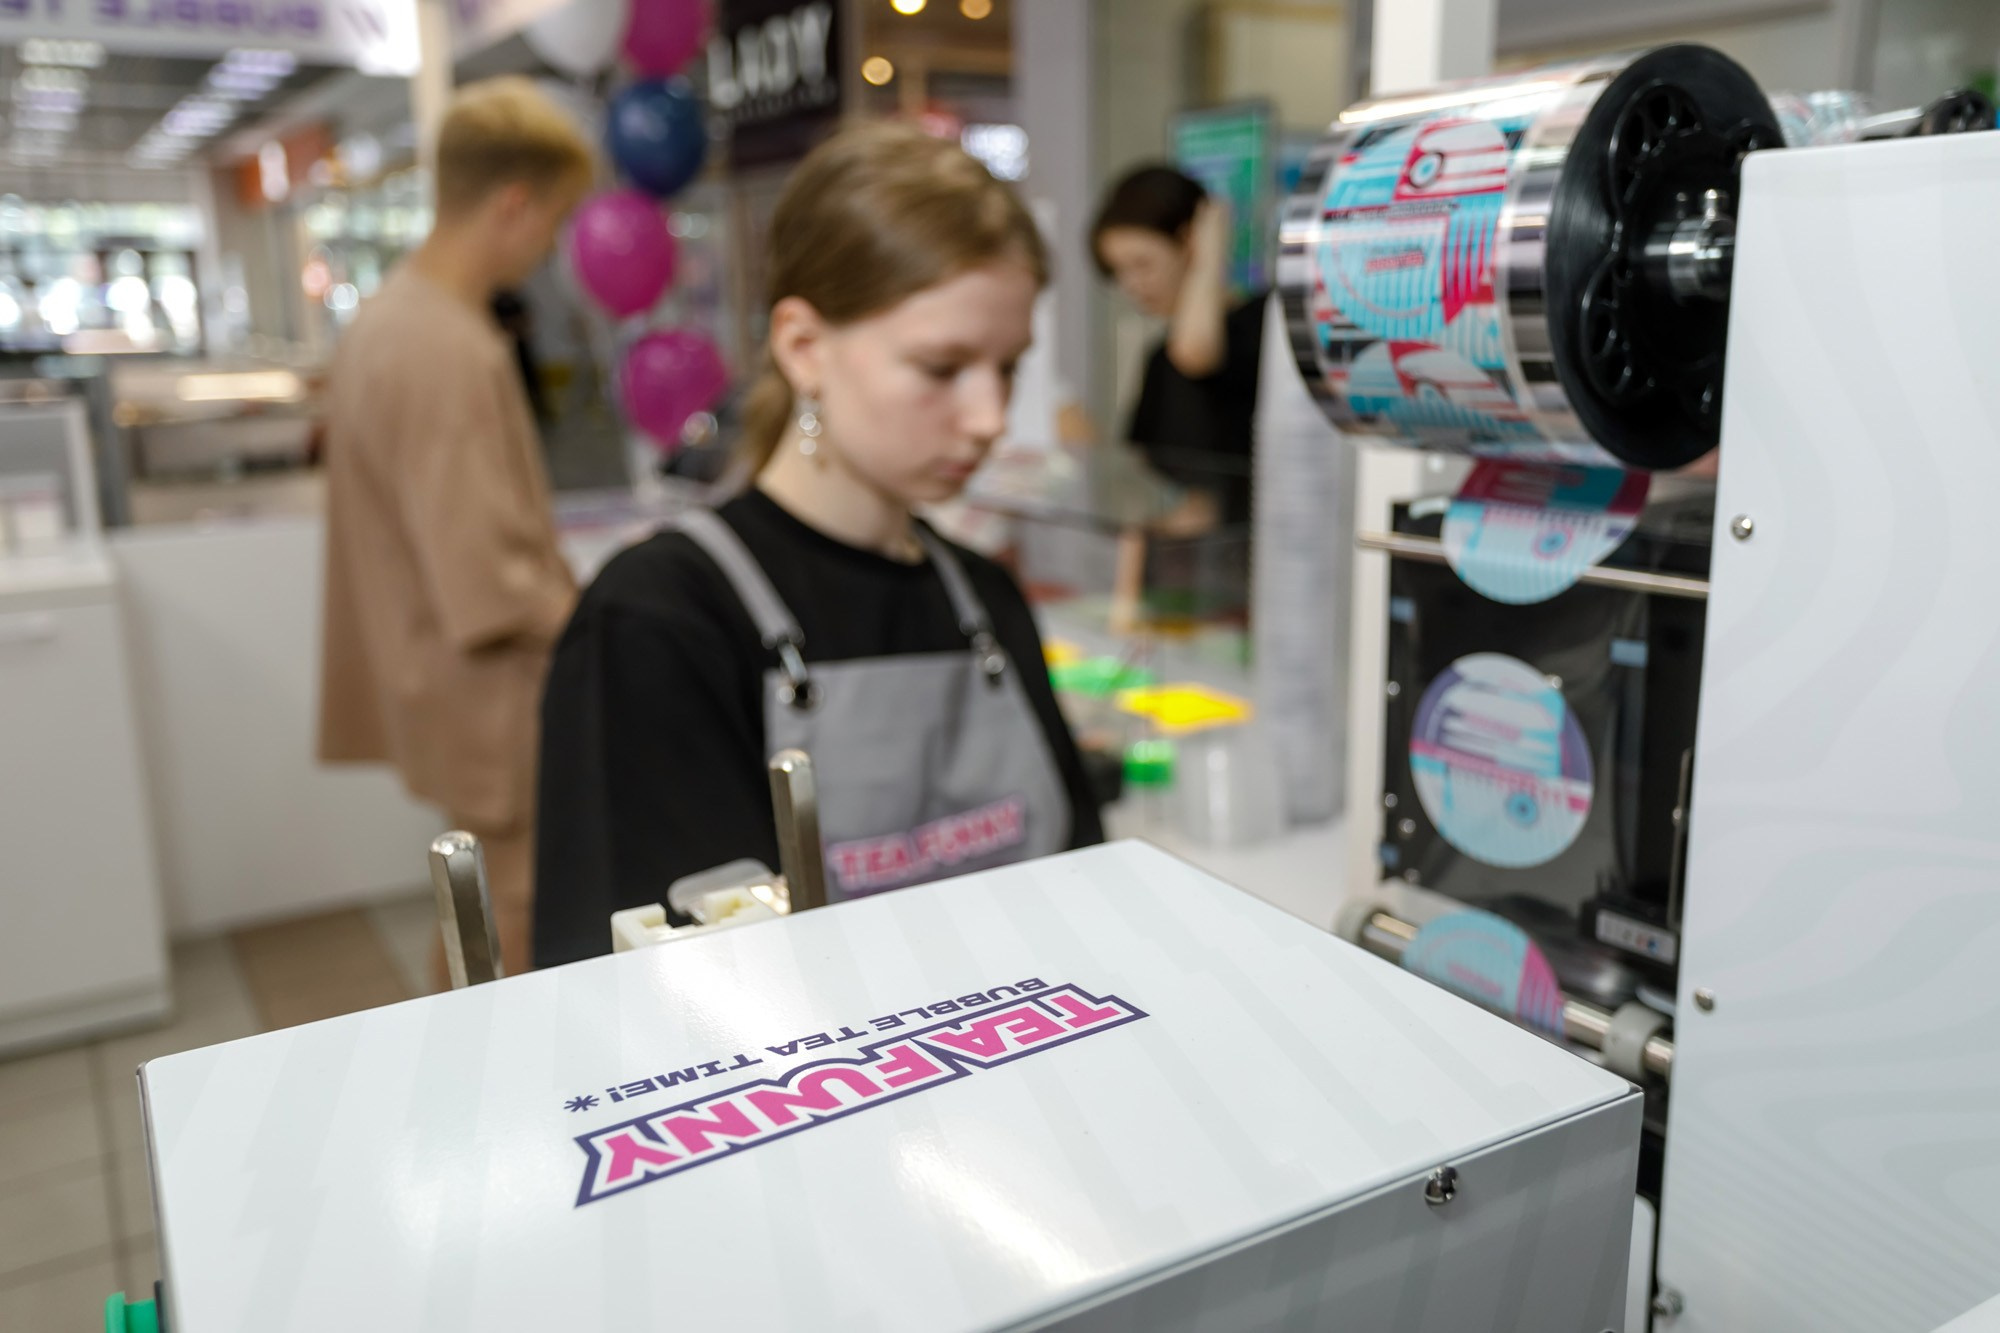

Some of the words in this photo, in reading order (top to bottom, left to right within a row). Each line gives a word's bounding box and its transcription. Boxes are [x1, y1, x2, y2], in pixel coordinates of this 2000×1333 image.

[830, 836, 912, 888] TEA
[867, 977, 1050, 1032] BUBBLE
[764, 1026, 870, 1057] TEA
[605, 1053, 764, 1104] TIME!
